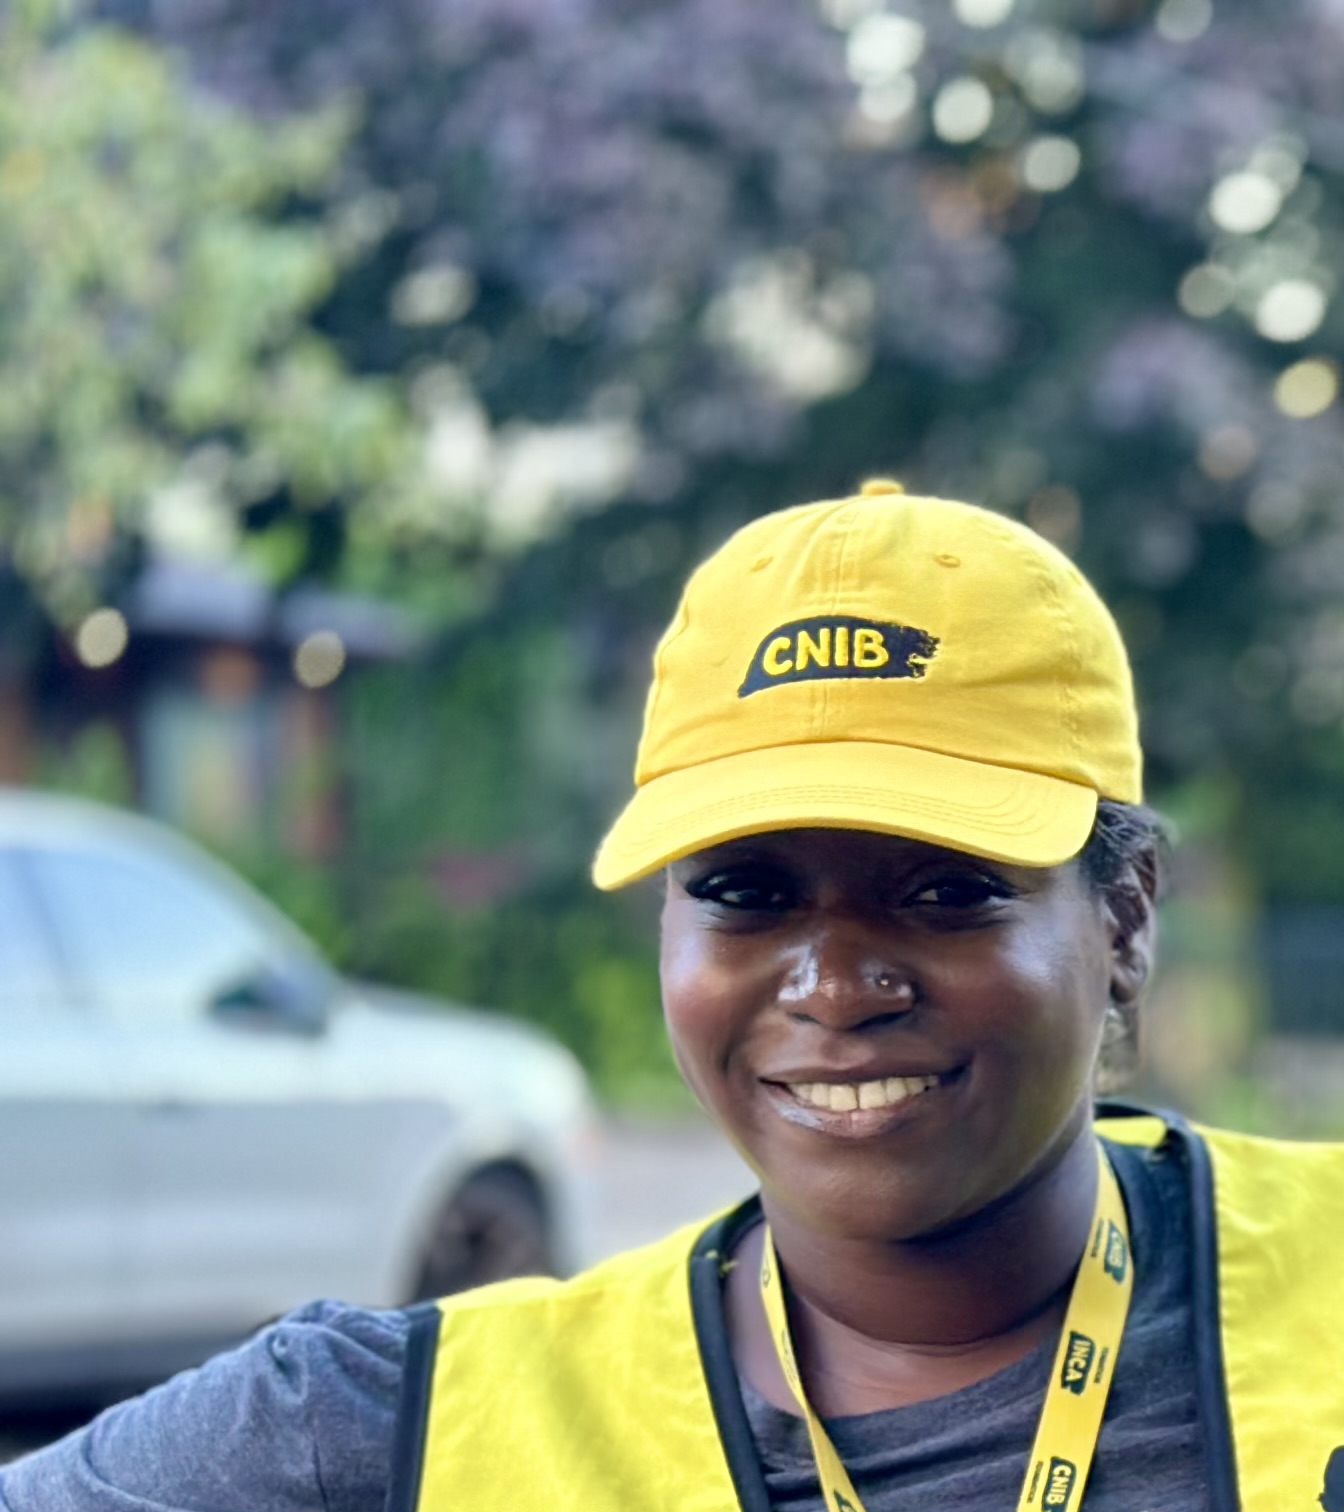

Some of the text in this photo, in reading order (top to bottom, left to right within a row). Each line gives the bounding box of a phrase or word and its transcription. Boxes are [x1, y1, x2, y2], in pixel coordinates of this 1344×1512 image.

[763, 627, 889, 676] CNIB
[1065, 1339, 1091, 1382] INCA
[1046, 1463, 1072, 1505] CNIB
